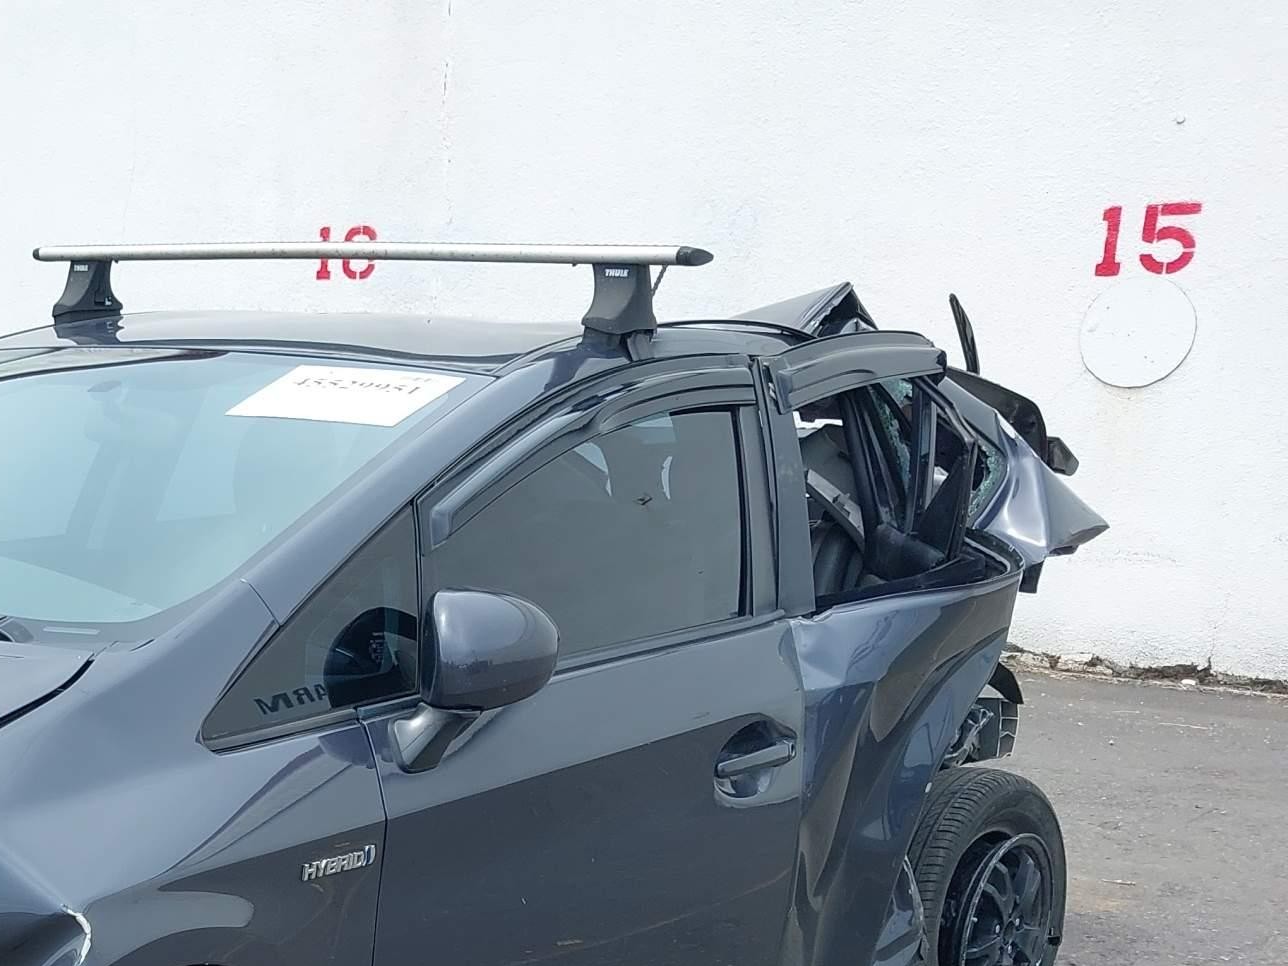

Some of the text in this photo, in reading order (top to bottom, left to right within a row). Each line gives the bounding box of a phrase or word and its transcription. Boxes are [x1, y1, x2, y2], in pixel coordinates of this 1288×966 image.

[1094, 202, 1202, 276] 15
[604, 268, 630, 278] THULE
[301, 850, 366, 882] HYBRID
